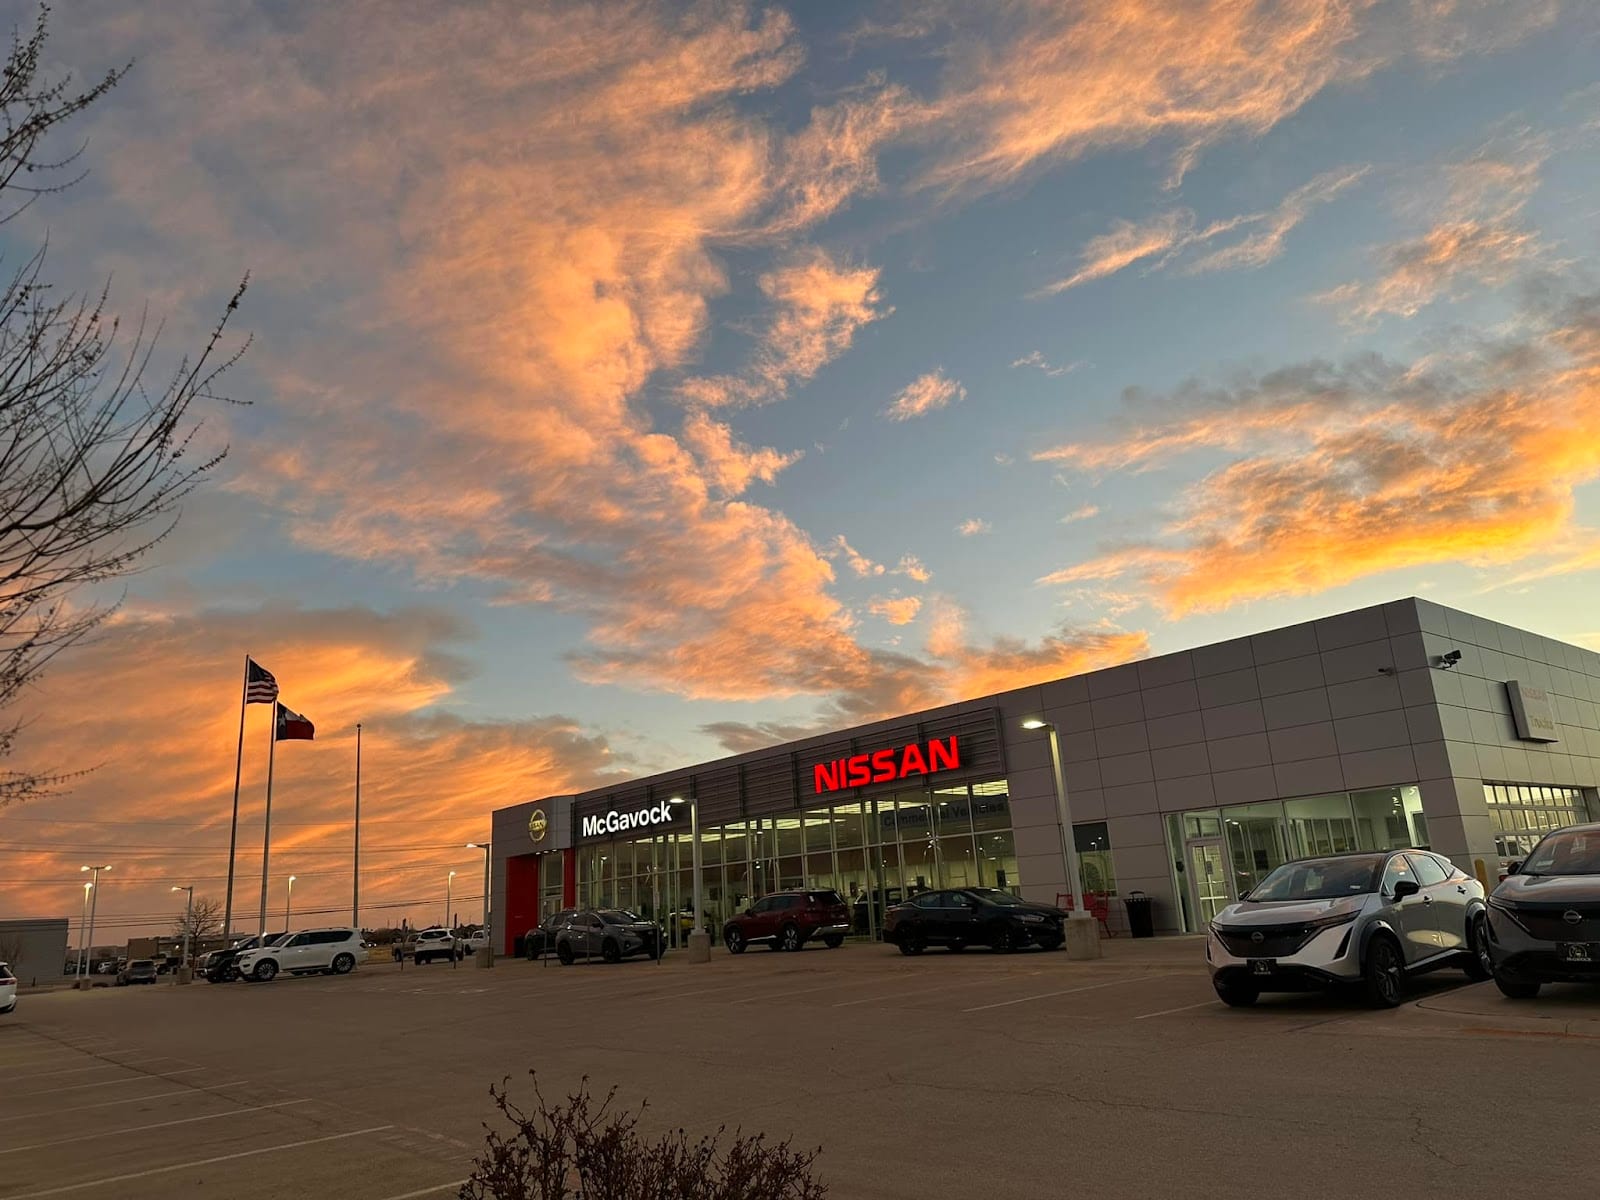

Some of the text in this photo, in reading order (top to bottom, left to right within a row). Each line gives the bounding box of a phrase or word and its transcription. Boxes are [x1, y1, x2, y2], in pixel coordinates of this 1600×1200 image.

[814, 735, 960, 793] NISSAN
[582, 801, 673, 837] McGavock
[952, 802, 1005, 818] Veicles
